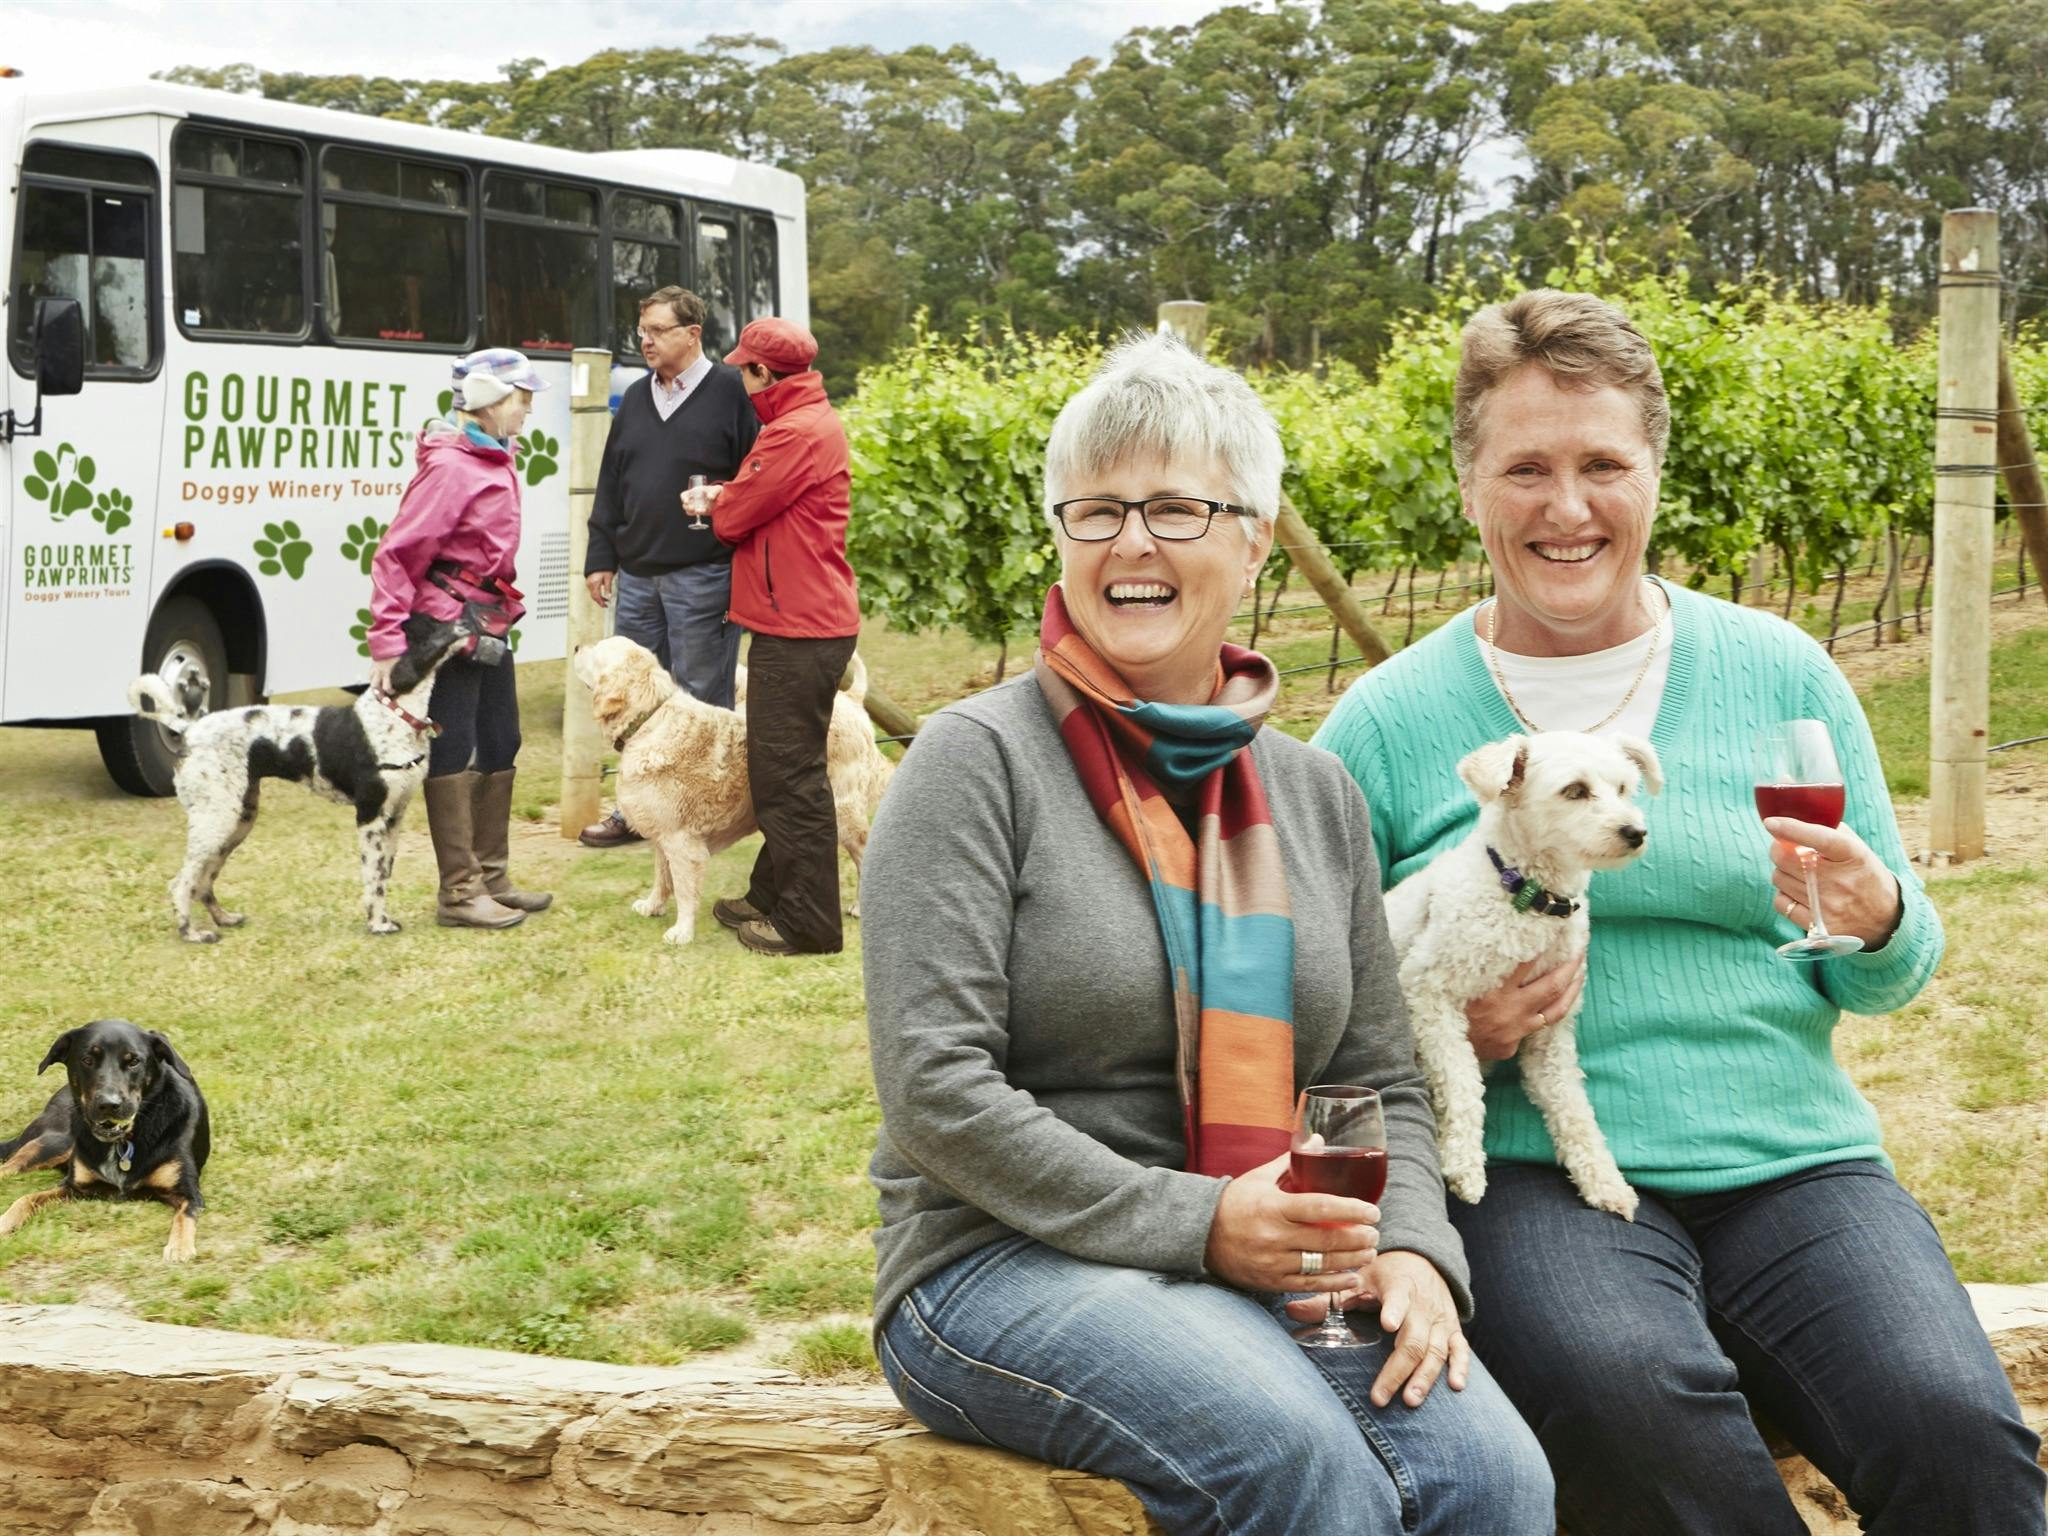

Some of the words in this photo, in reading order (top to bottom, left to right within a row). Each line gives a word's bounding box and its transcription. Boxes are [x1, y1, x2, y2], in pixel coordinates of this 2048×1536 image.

[184, 370, 407, 428] GOURMET
[182, 480, 259, 505] Doggy
[268, 480, 343, 501] Winery
[351, 479, 403, 496] Tours
[24, 544, 132, 567] GOURMET
[24, 592, 60, 603] Doggy
[64, 590, 100, 599] Winery
[104, 588, 130, 597] Tours
